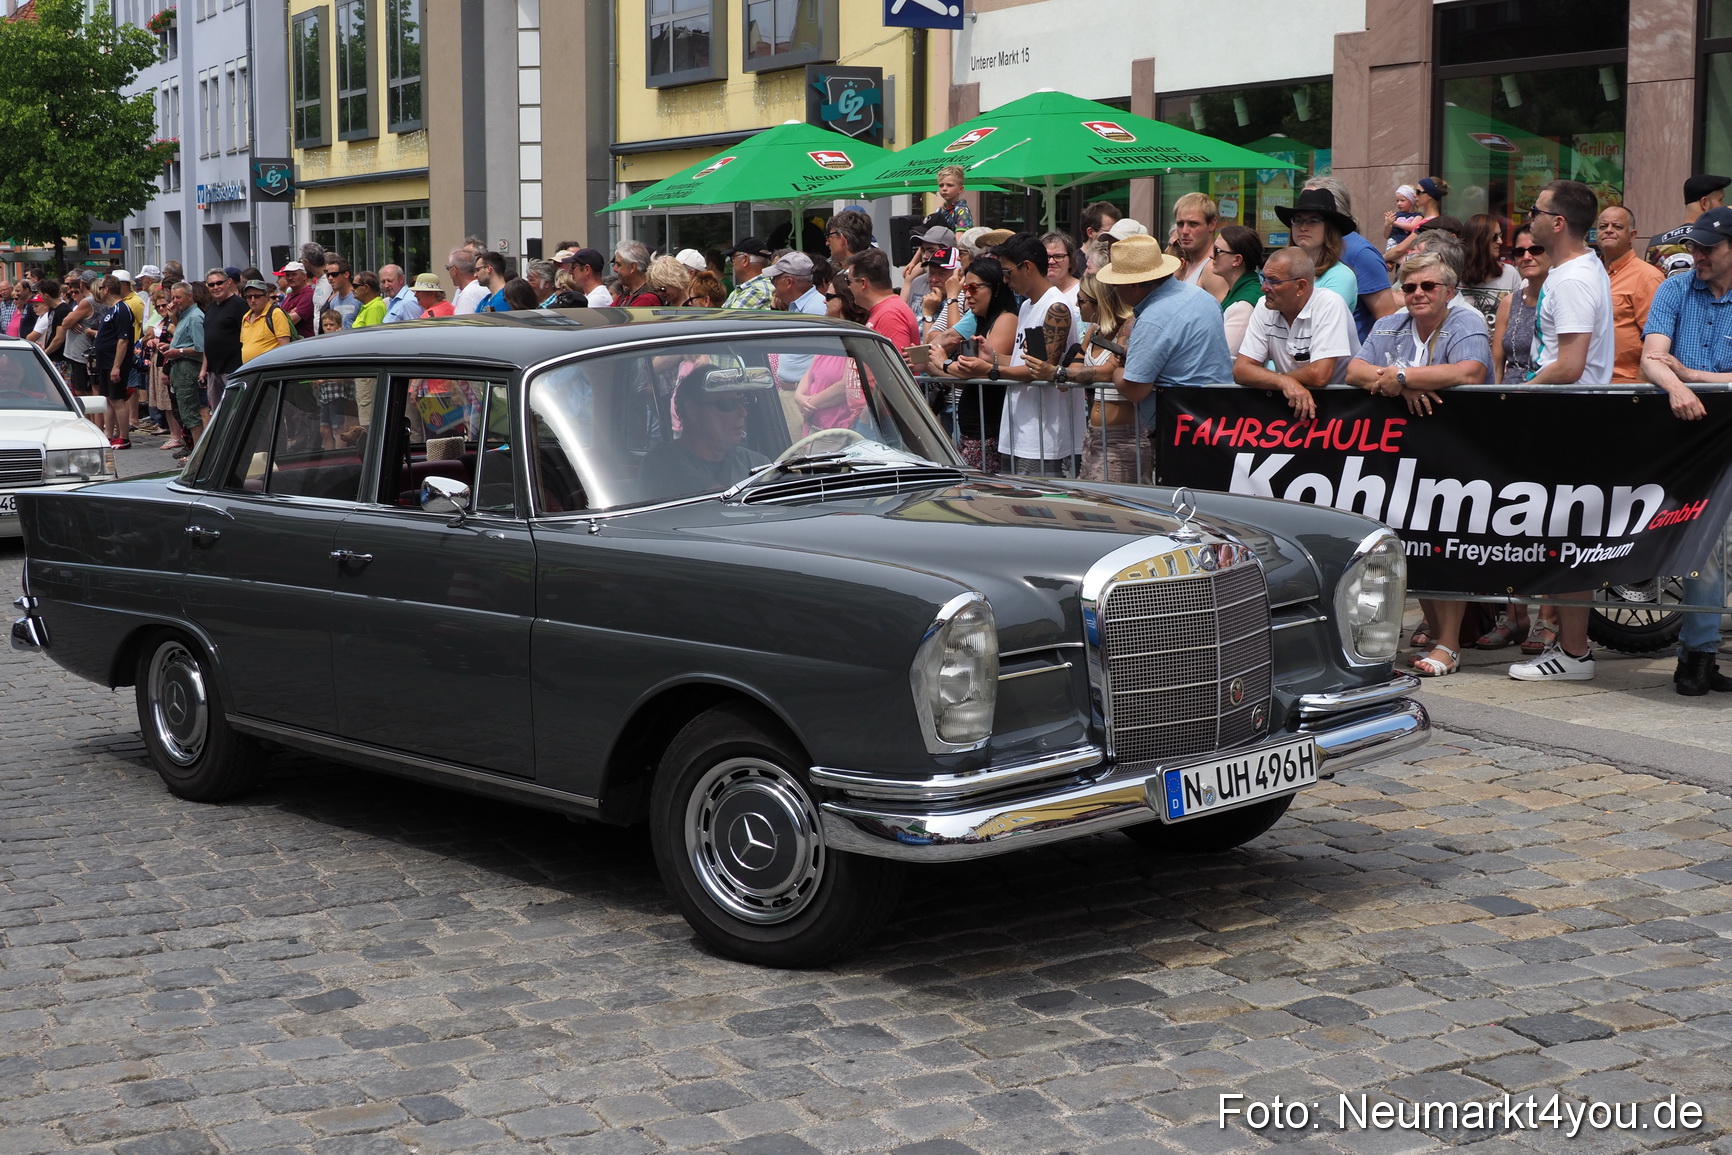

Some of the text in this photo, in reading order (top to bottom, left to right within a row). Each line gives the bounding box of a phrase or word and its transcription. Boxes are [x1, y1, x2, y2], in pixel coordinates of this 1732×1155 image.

[970, 47, 1030, 71] Unterer Markt 15
[838, 88, 864, 122] G2
[1087, 152, 1213, 166] Lammsbräu
[1092, 145, 1181, 155] Neumarkter
[1578, 142, 1620, 157] Grillen
[1522, 154, 1548, 168] BURGER
[266, 169, 281, 188] G2
[1173, 414, 1408, 453] FAHRSCHULE
[1228, 452, 1709, 537] Kohlmann GmbH
[1445, 538, 1546, 566] Freystadt
[1559, 541, 1635, 569] Pyrbaum
